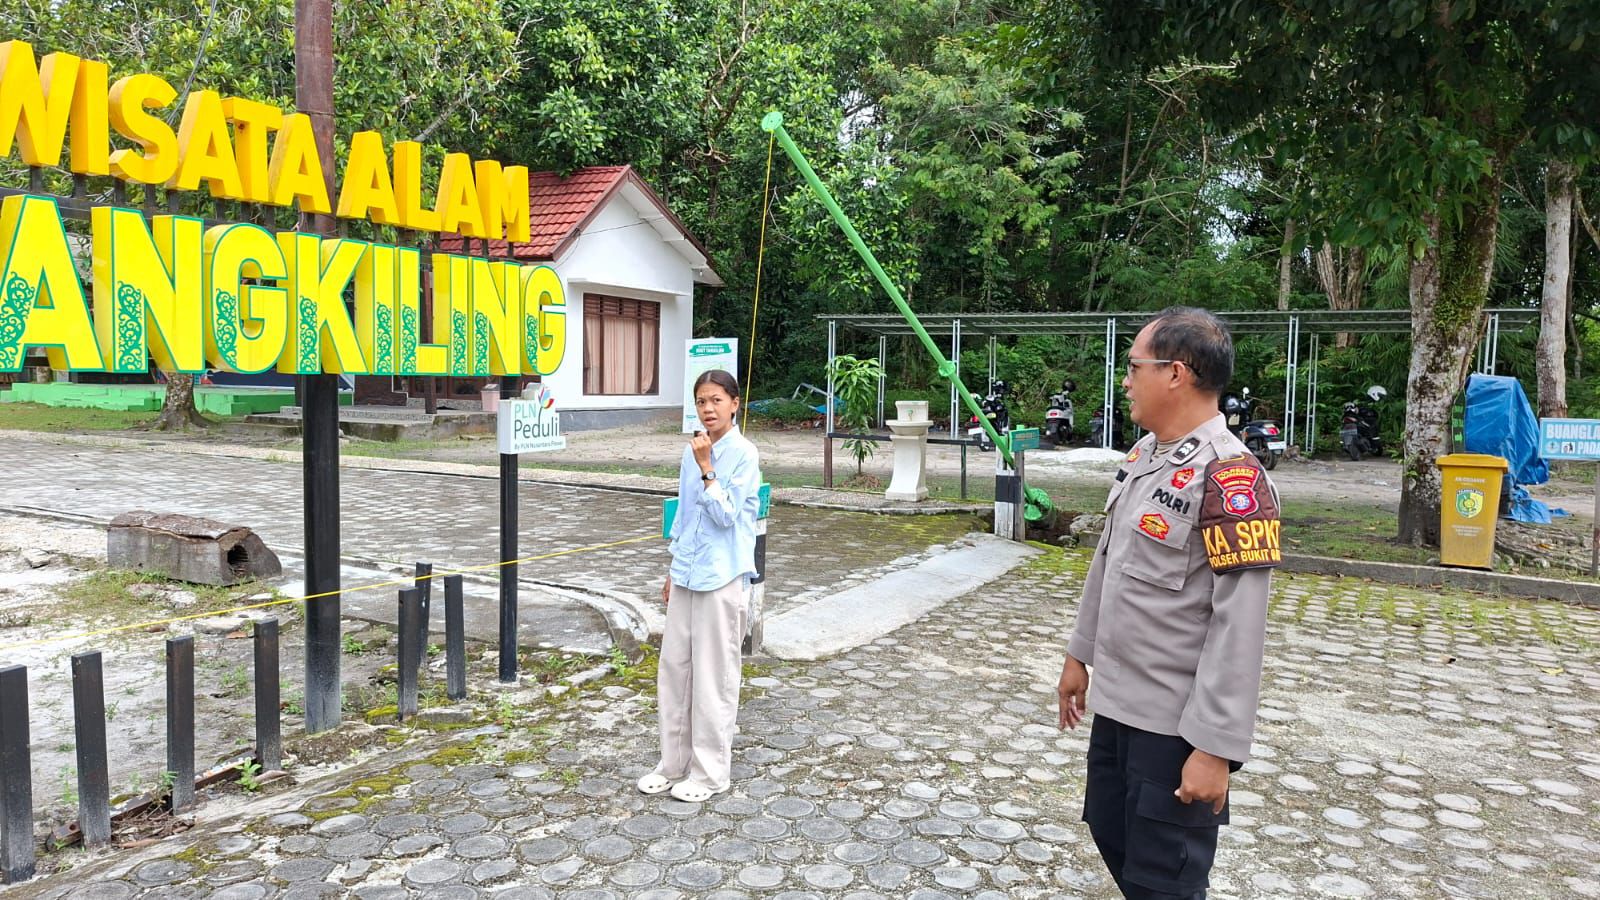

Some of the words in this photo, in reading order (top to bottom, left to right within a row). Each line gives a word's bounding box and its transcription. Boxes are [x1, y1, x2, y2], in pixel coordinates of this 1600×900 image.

[0, 40, 331, 213] WISATA
[337, 130, 530, 243] ALAM
[514, 403, 536, 418] PLN
[514, 416, 558, 440] Peduli
[1152, 489, 1190, 515] POLRI
[1202, 525, 1231, 556] KA
[1236, 519, 1280, 550] SPKT
[1208, 552, 1240, 568] POLSEK
[1240, 548, 1269, 562] BUKIT
